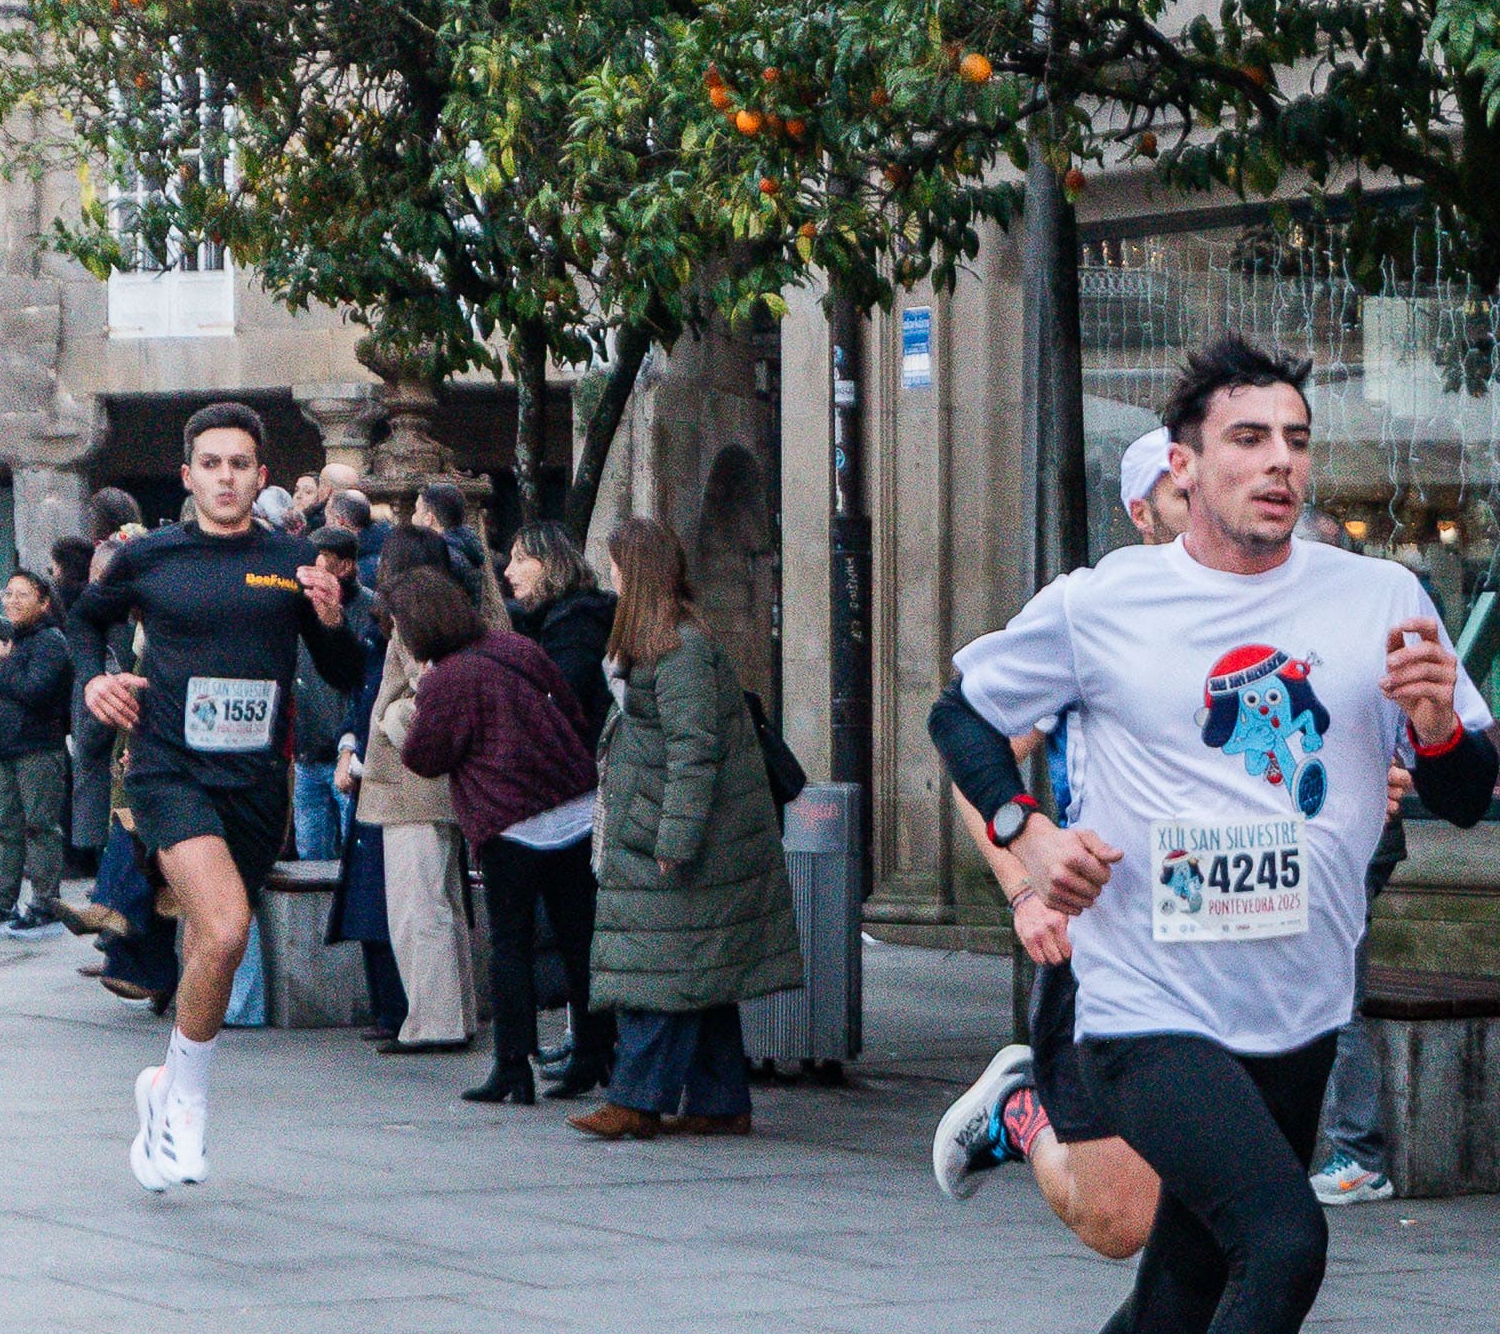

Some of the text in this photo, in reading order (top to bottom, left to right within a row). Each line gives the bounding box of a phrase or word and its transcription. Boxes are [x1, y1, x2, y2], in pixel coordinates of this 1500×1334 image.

[223, 698, 267, 721] 1553
[1190, 827, 1220, 850] SAN
[1226, 821, 1298, 850] SILVESTRE
[1208, 848, 1300, 893] 4245
[1209, 892, 1301, 915] PONTEVEDRA 2025
